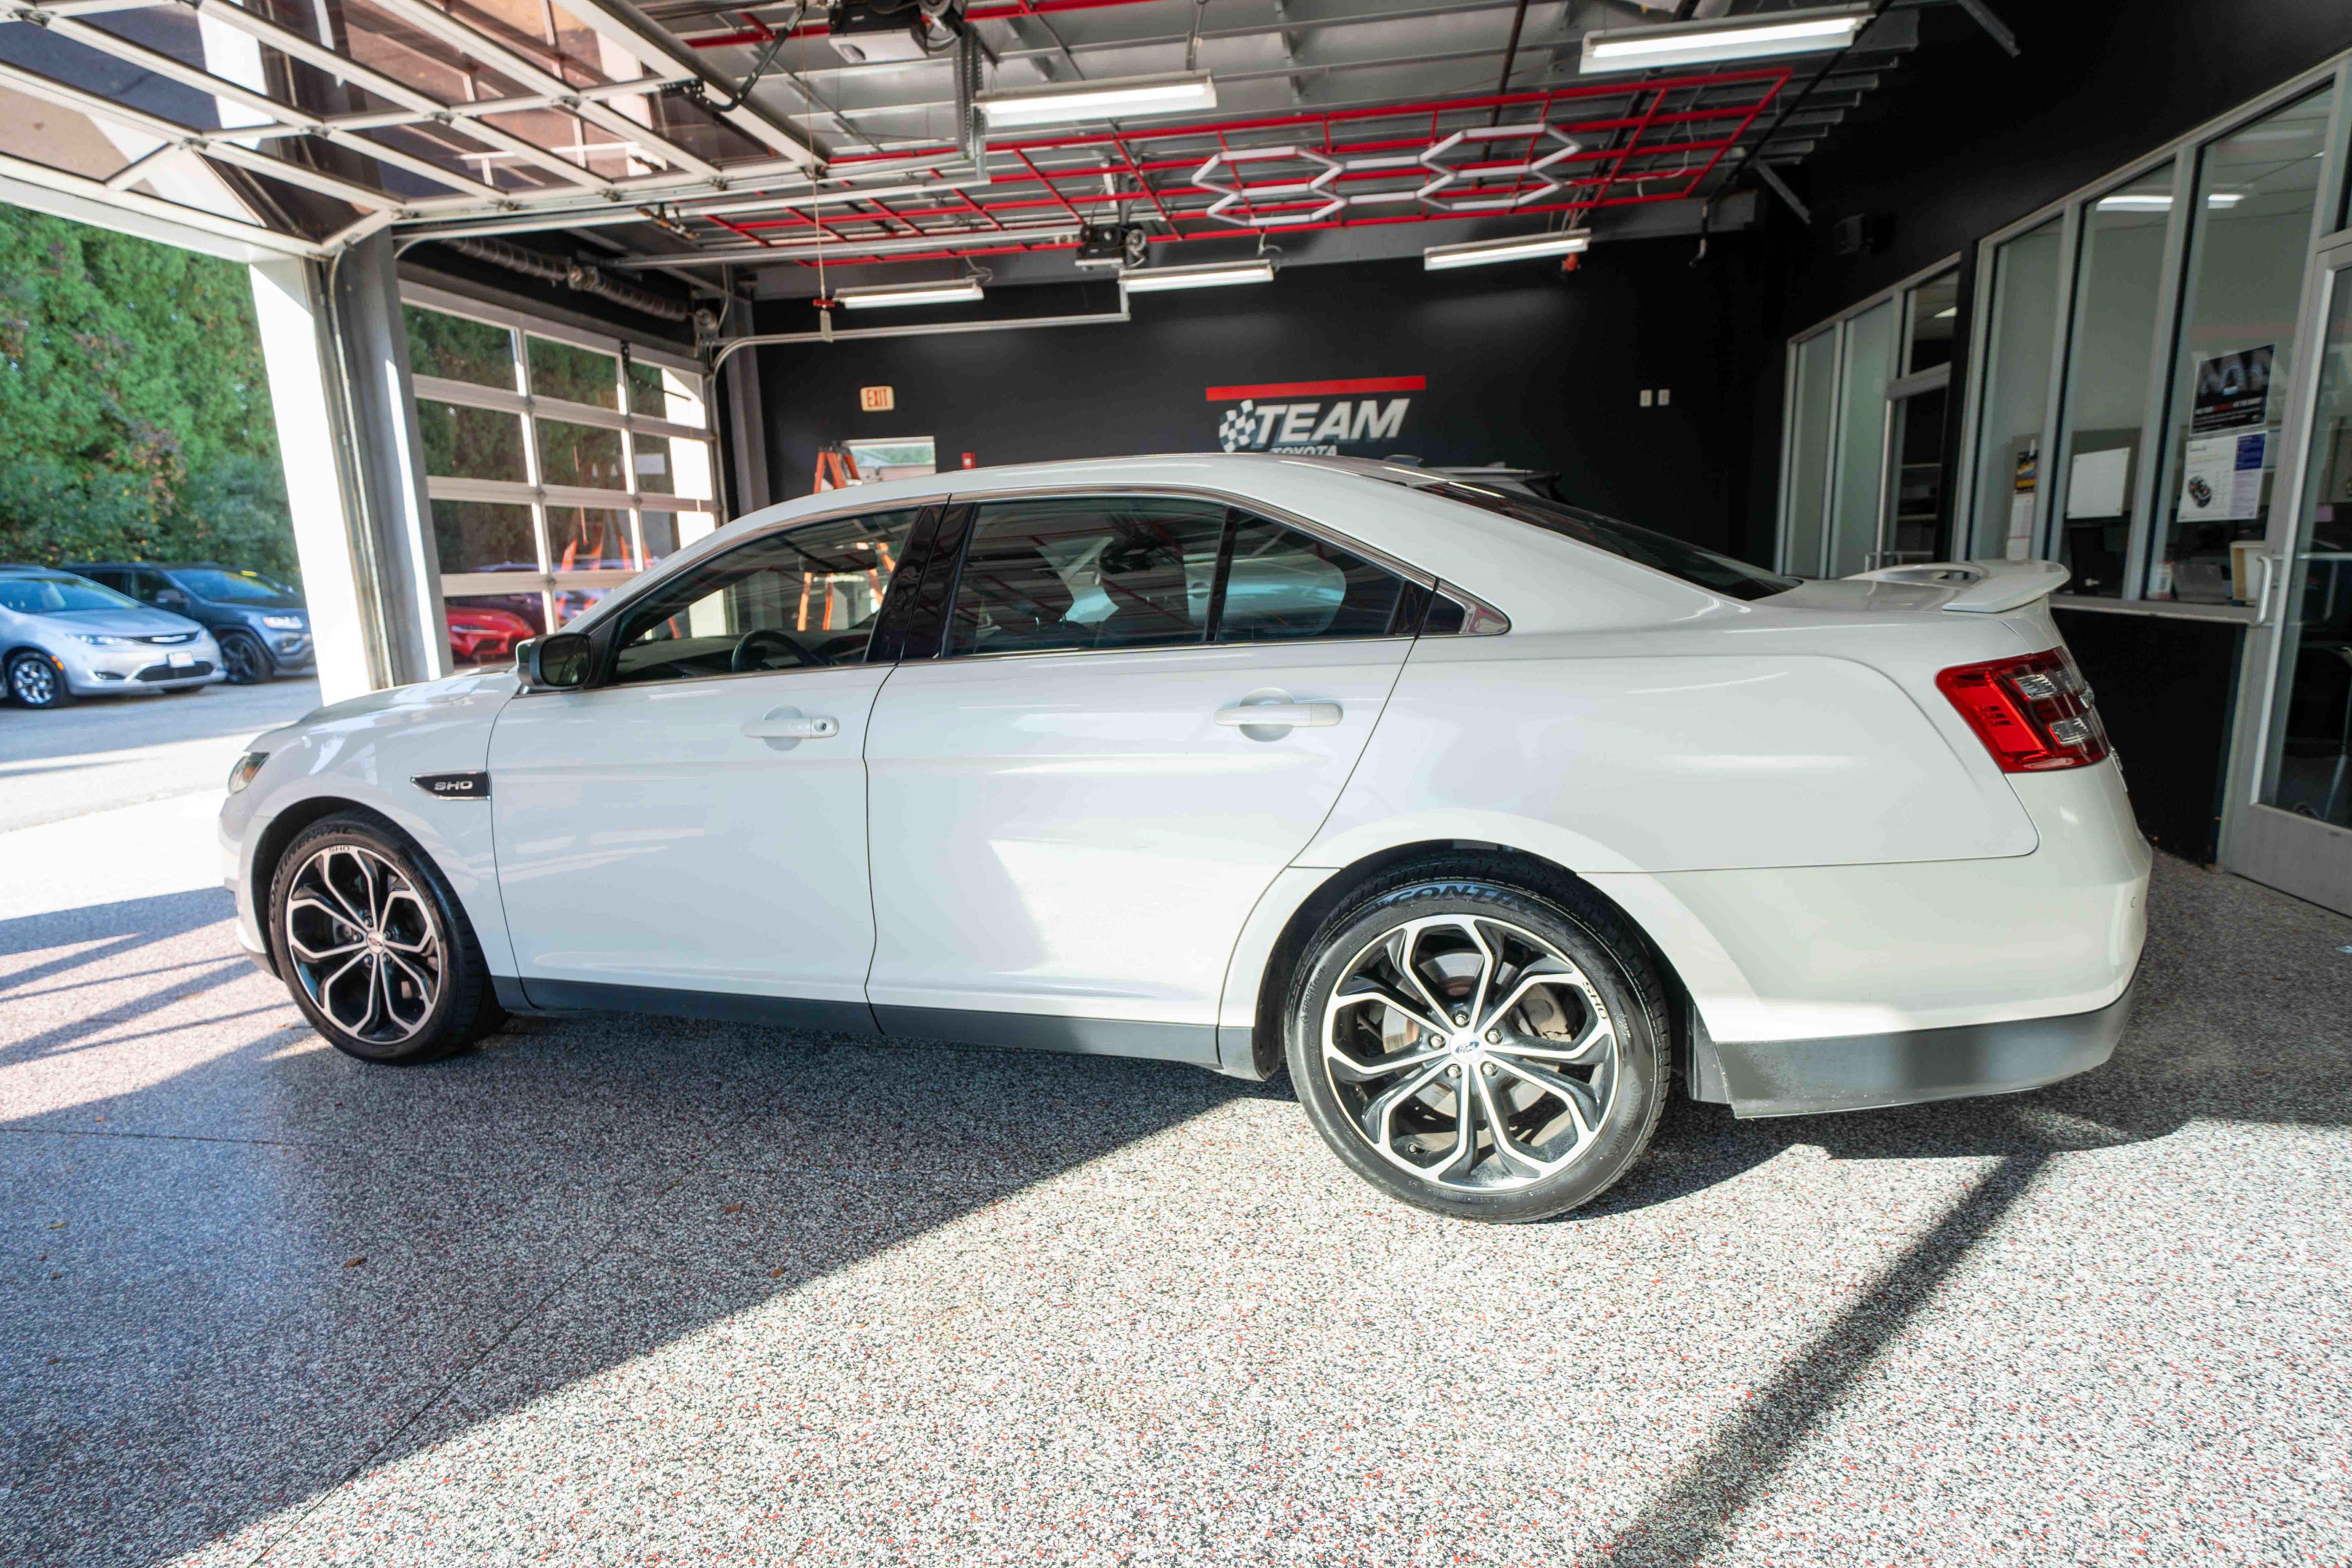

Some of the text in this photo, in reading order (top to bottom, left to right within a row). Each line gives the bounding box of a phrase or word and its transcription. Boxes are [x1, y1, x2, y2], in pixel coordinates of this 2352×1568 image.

[866, 388, 888, 408] EXIT
[1254, 398, 1411, 445] TEAM
[433, 780, 474, 791] SHO
